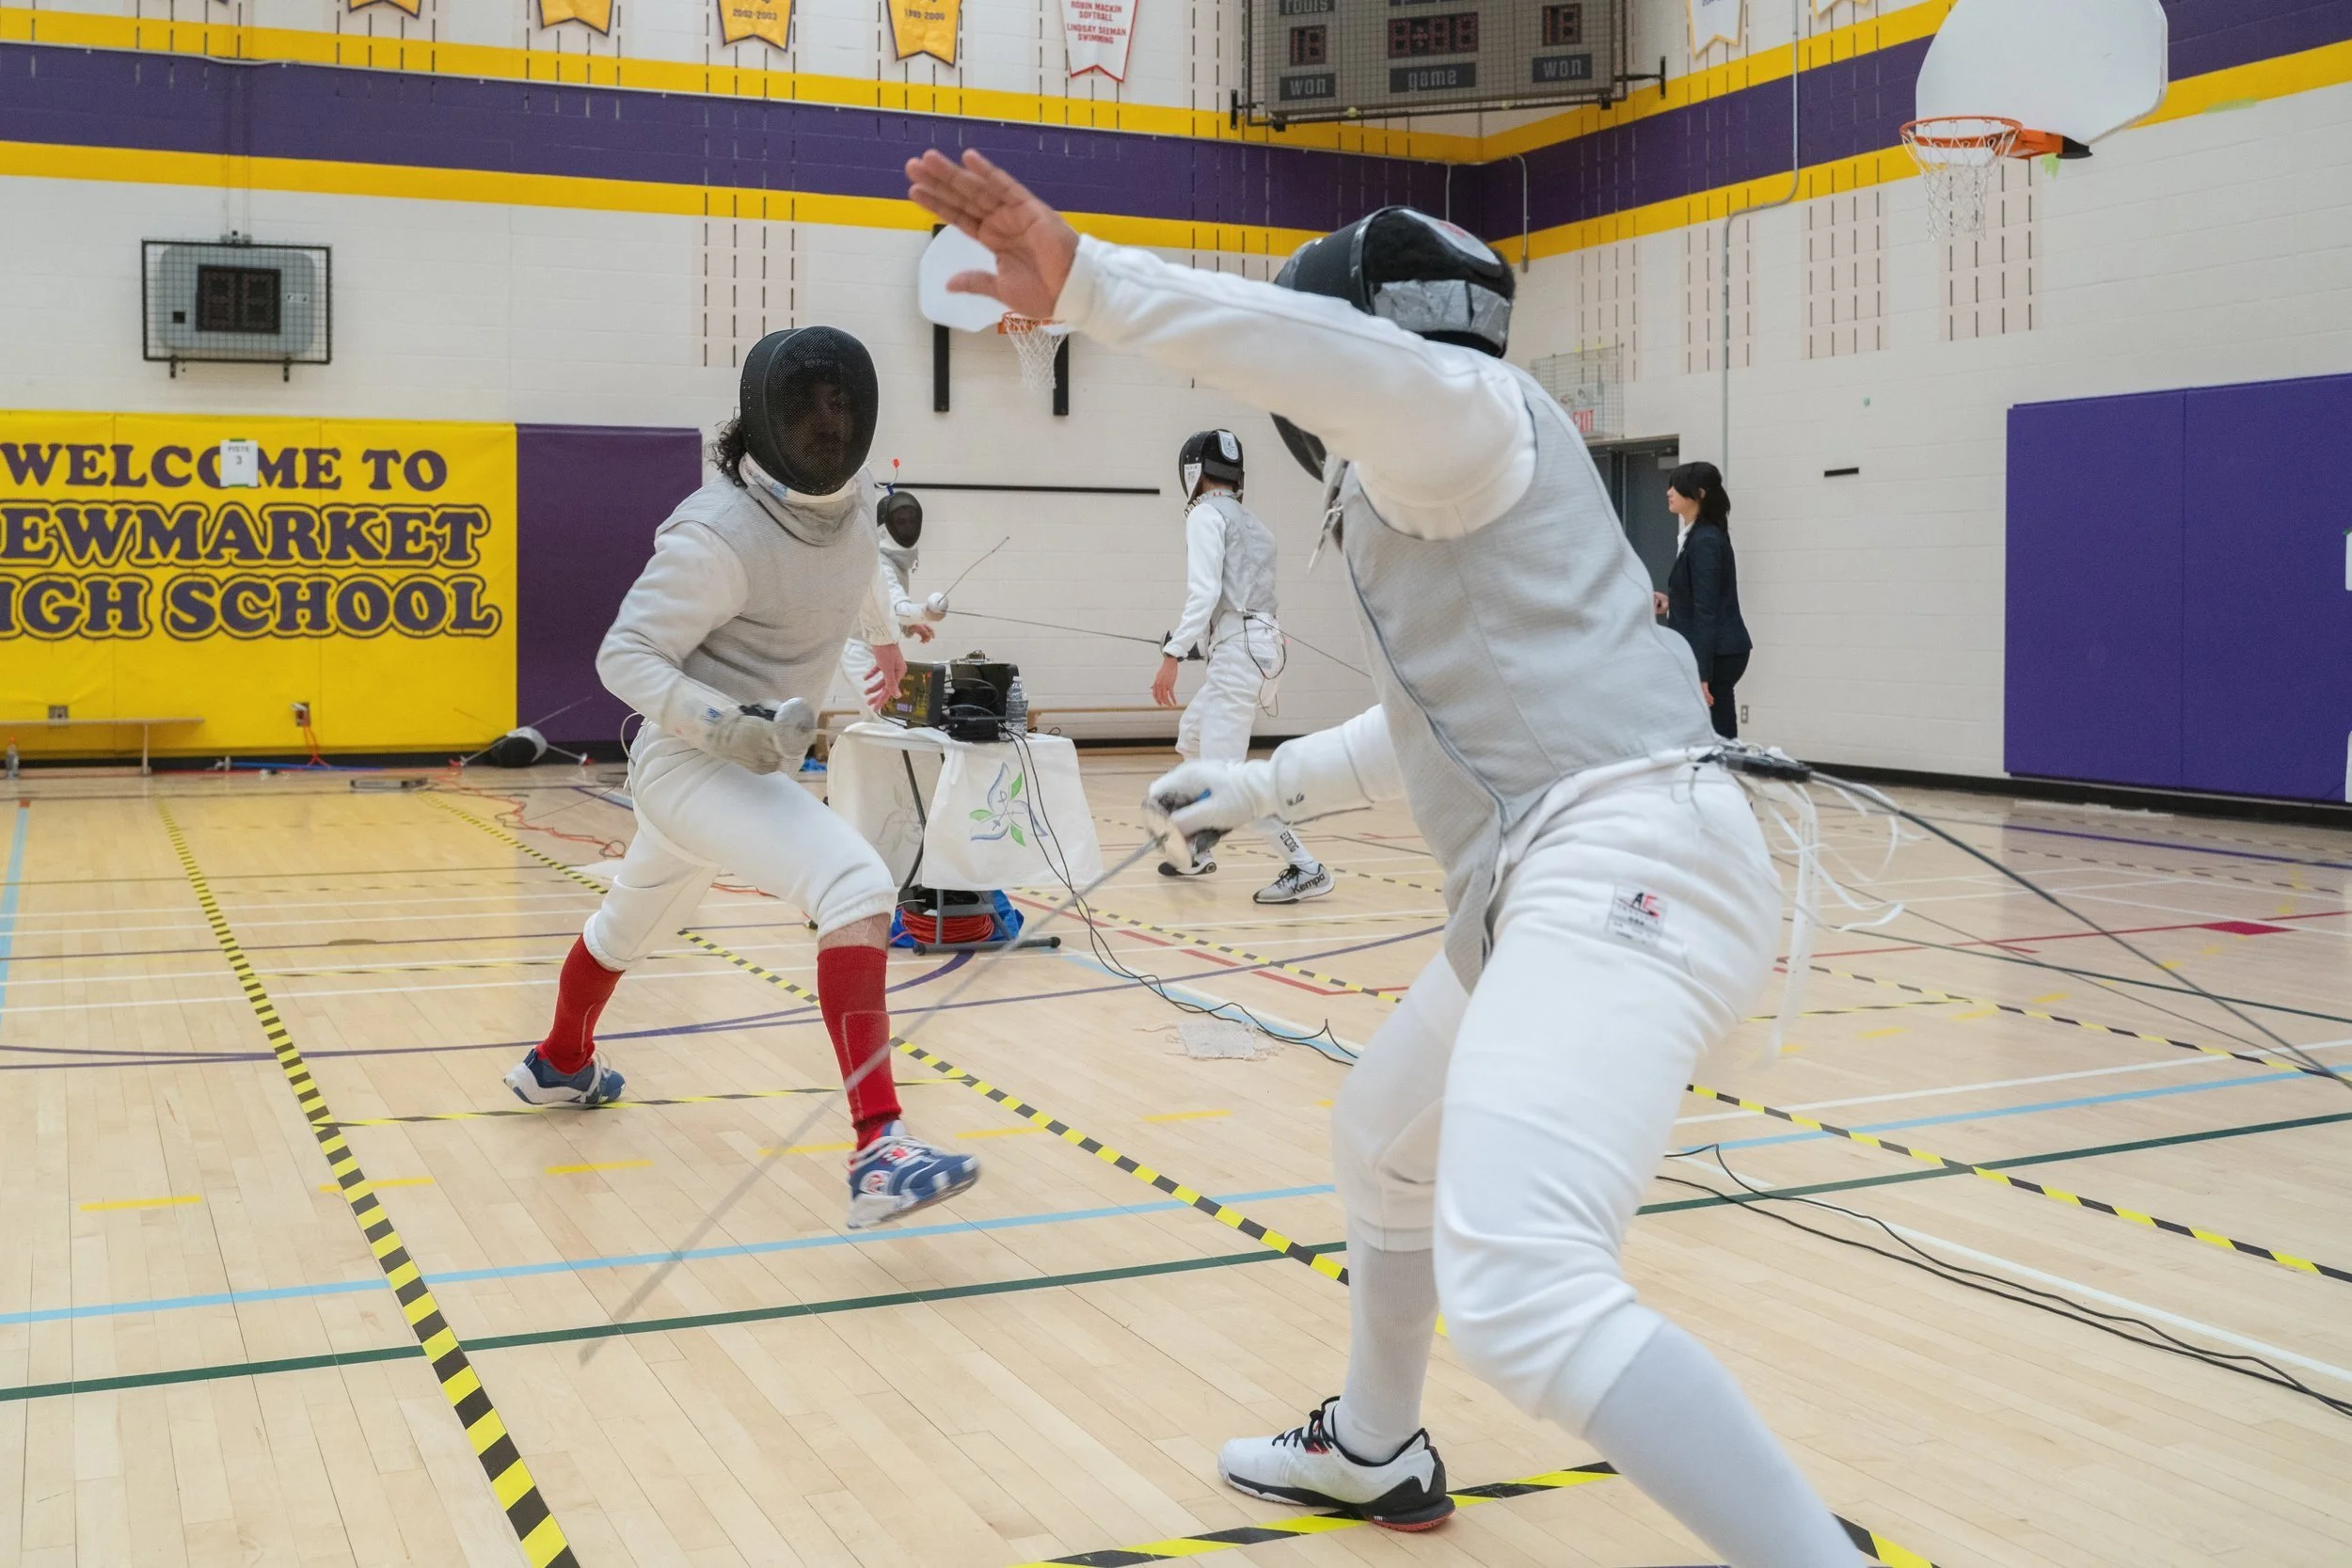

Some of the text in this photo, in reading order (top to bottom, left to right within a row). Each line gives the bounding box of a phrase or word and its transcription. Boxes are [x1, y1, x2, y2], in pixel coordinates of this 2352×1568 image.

[1079, 10, 1114, 22] SOFTBALL
[1067, 23, 1097, 33] LINDSAY
[1078, 33, 1114, 44] SWIMMING
[1544, 59, 1581, 77] won
[1290, 78, 1327, 96] won
[1408, 70, 1457, 92] game
[361, 448, 448, 492] TO
[163, 575, 501, 641] SCHOOL
[1292, 873, 1326, 895] Kempa
